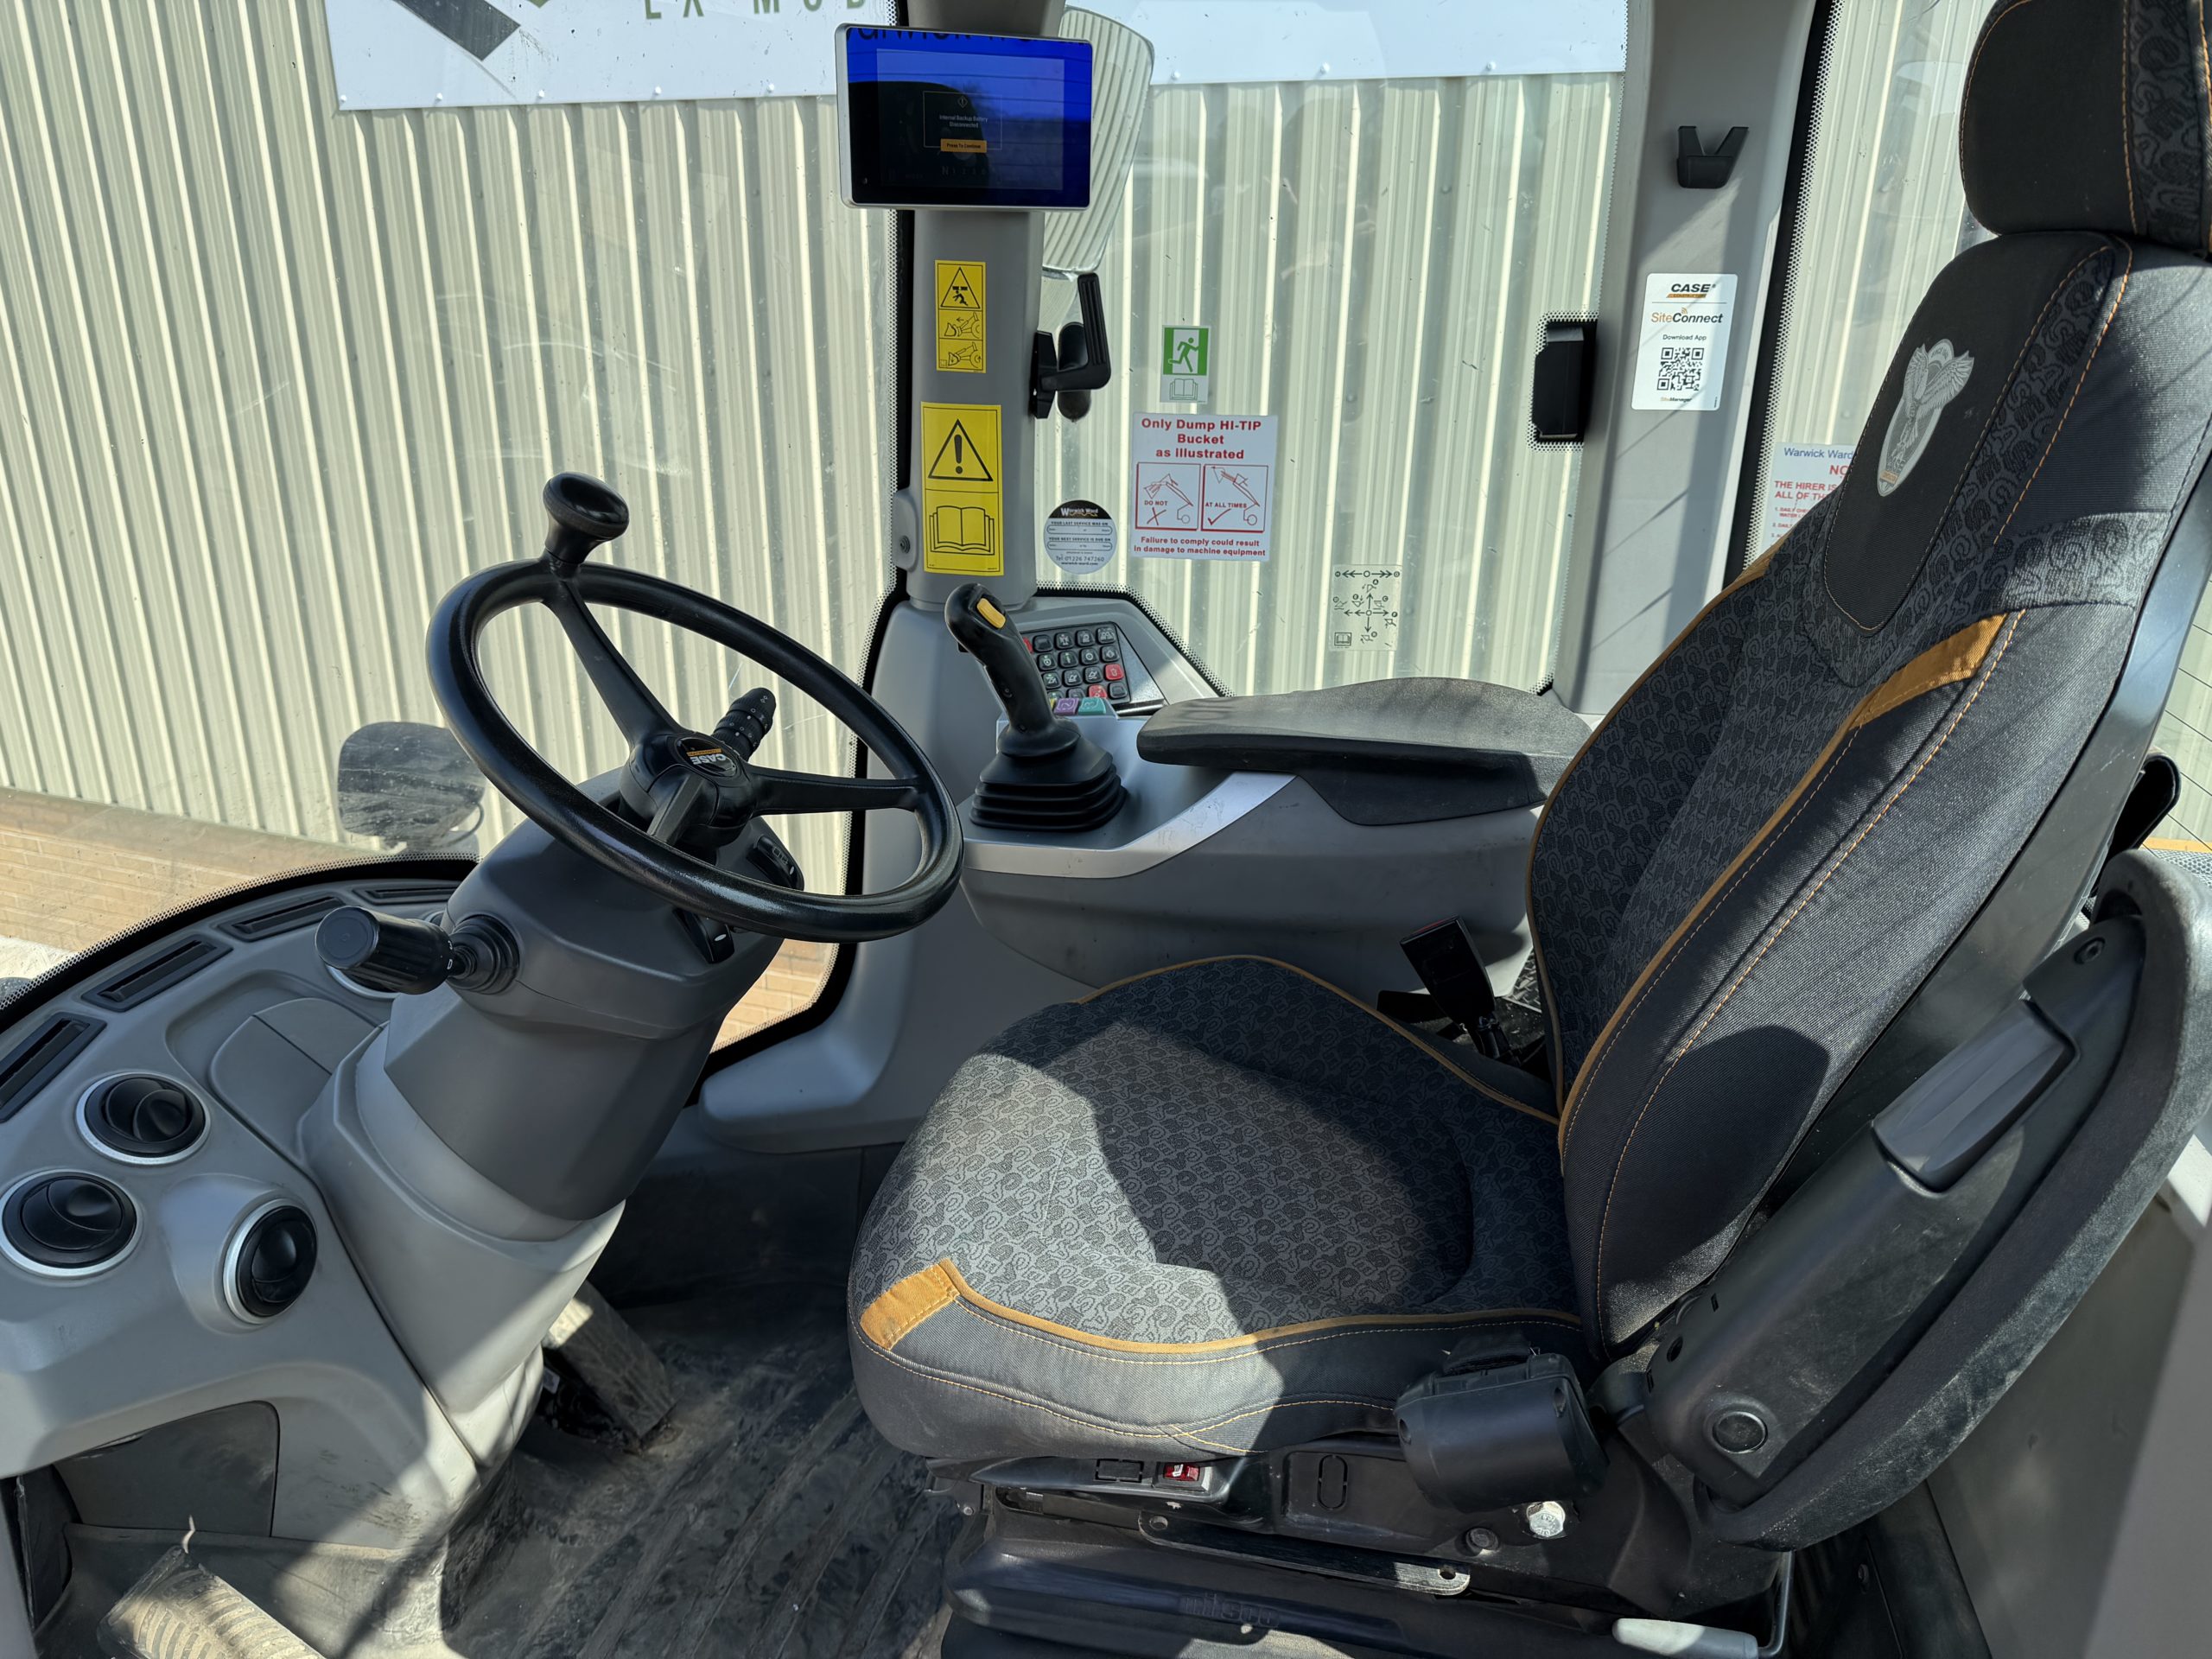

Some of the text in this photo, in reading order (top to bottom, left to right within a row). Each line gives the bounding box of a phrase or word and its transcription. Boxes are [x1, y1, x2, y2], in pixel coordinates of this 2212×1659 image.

[1651, 312, 1724, 323] SiteConnect
[1141, 418, 1262, 432] Only Dump HI-TIP
[1177, 434, 1224, 444] Bucket
[1784, 448, 1825, 458] Warwick
[1796, 482, 1826, 491] HIRER
[1223, 548, 1266, 556] equipment
[690, 753, 727, 765] CASE
